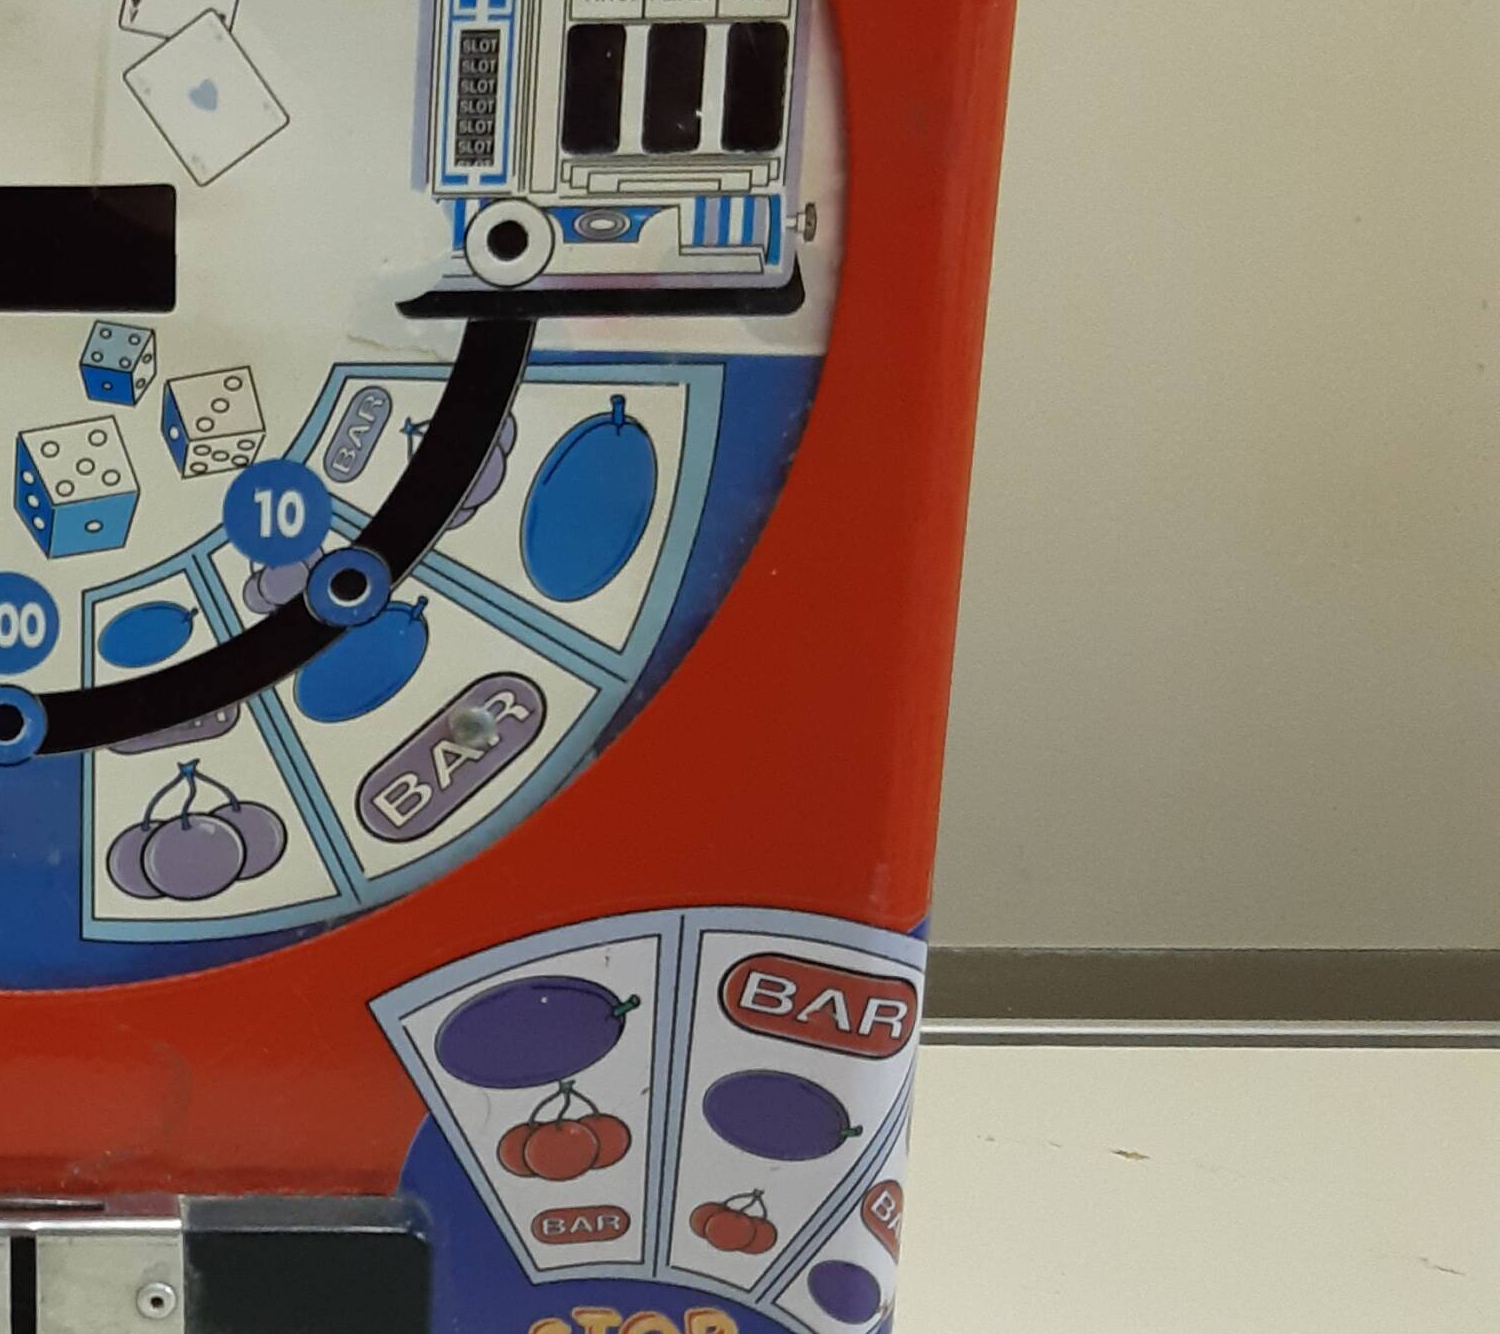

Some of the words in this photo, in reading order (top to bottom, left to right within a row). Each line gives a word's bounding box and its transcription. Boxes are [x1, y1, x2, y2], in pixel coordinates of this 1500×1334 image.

[463, 38, 497, 53] SLOT
[462, 59, 496, 74] SLOT
[461, 79, 496, 94] SLOT
[460, 99, 494, 114] SLOT
[459, 120, 493, 135] SLOT
[458, 140, 493, 155] SLOT
[332, 392, 386, 475] BAR
[253, 489, 306, 539] 10
[371, 689, 534, 828] BAR
[739, 971, 910, 1039] BAR
[541, 1210, 623, 1236] BAR
[871, 1190, 901, 1241] BA
